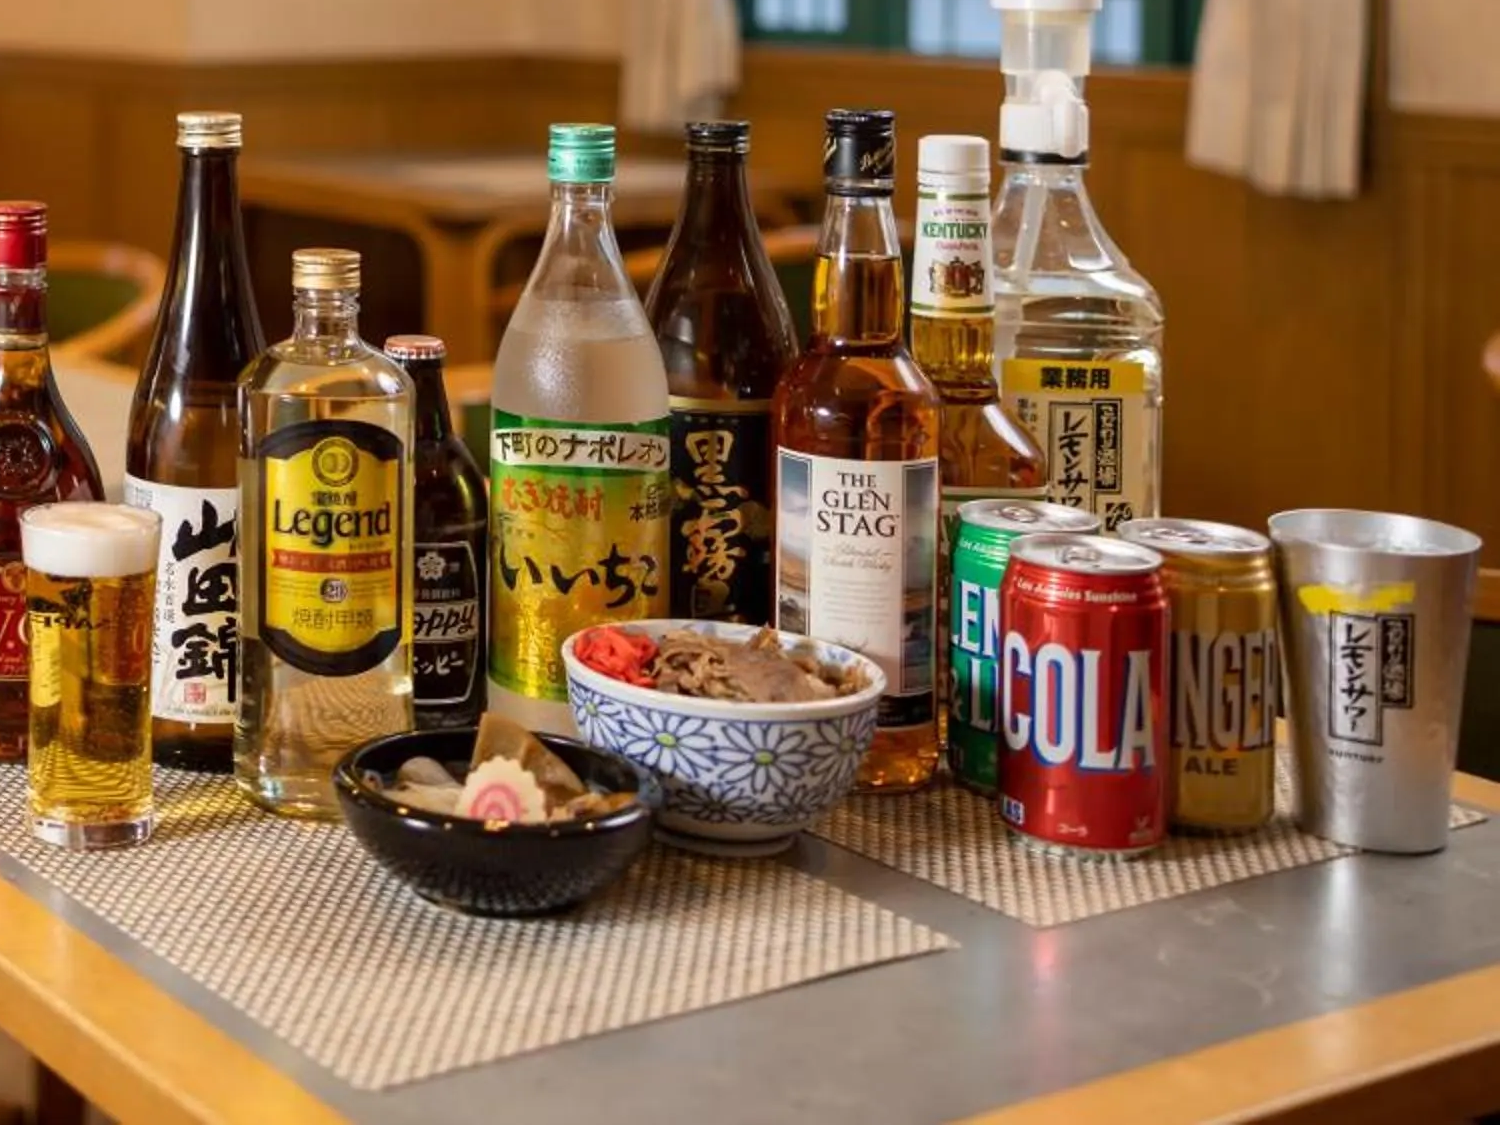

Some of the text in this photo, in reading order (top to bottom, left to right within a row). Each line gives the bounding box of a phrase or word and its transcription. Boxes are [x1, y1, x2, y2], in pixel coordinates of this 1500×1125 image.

[922, 221, 989, 239] KENTUCKY
[1041, 366, 1111, 390] 業務用
[495, 431, 668, 468] 下町のナポレオン
[1058, 411, 1090, 508] レモンサワ
[503, 477, 605, 521] むぎ焼酎
[837, 472, 877, 489] THE
[822, 489, 892, 512] GLEN
[273, 497, 392, 550] Legend
[817, 510, 897, 538] STAG
[500, 542, 659, 609] いいちこ
[171, 498, 238, 704] 山田錦
[414, 603, 475, 637] oppy
[1341, 624, 1374, 731] レモンサワー
[1003, 631, 1157, 771] COLA
[1185, 756, 1238, 776] ALE
